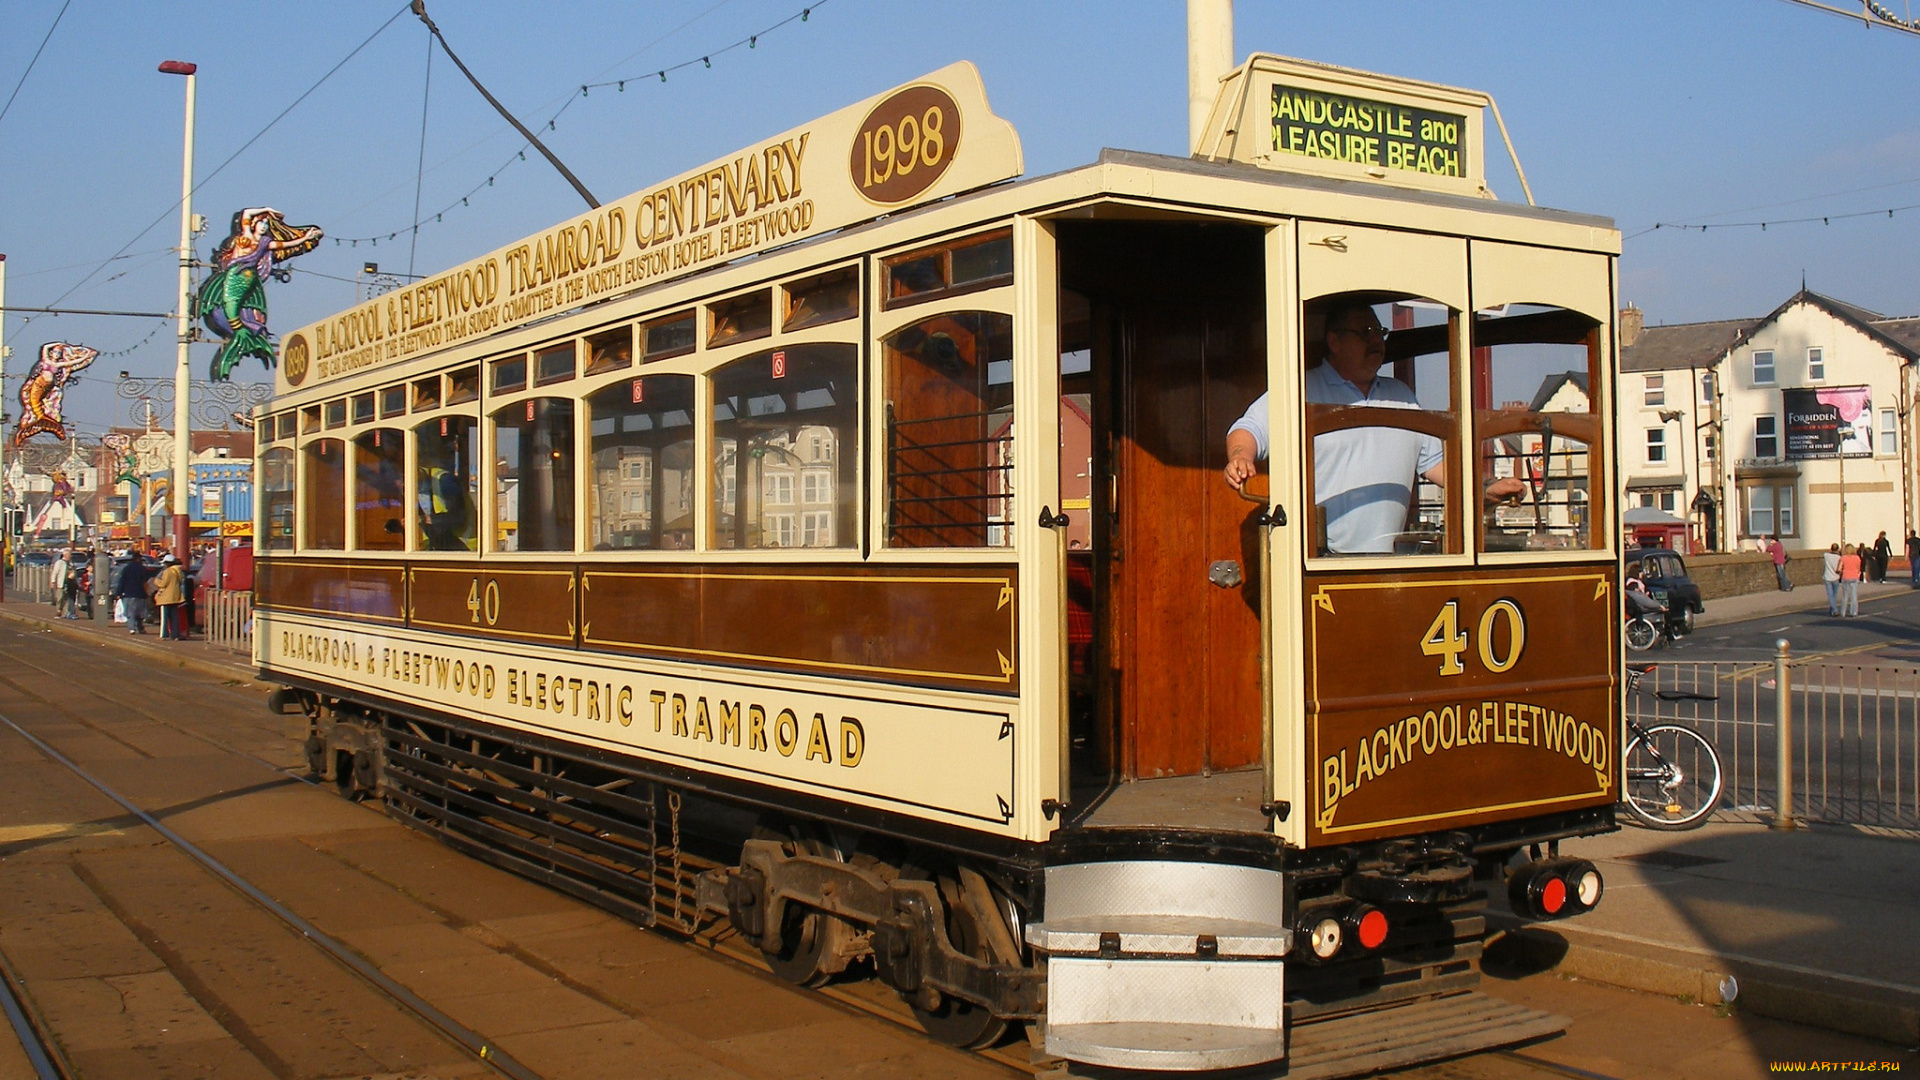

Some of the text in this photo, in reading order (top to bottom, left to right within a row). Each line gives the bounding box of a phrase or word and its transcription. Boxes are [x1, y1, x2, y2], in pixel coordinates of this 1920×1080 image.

[863, 105, 944, 188] 1998
[1272, 124, 1459, 177] LEASURE BEACH
[1420, 118, 1458, 145] and
[315, 131, 811, 360] BLACKPOOL & FLEETWOOD TRAMROAD CENTENARY
[385, 338, 398, 360] THE
[399, 324, 441, 355] FLEETWOOD
[444, 315, 468, 342] TRAM
[469, 304, 500, 335] SUNDAY
[502, 286, 554, 323] COMMITTEE
[556, 283, 564, 306] &
[565, 277, 584, 303] THE
[586, 261, 622, 297] NORTH
[624, 246, 671, 284] EUSTON
[720, 198, 815, 256] FLEETWOOD
[466, 577, 500, 626] 40
[1419, 598, 1526, 677] 40
[282, 630, 865, 768] BLACKPOOL & FLEETWOOD ELECTRIC TRAMROAD
